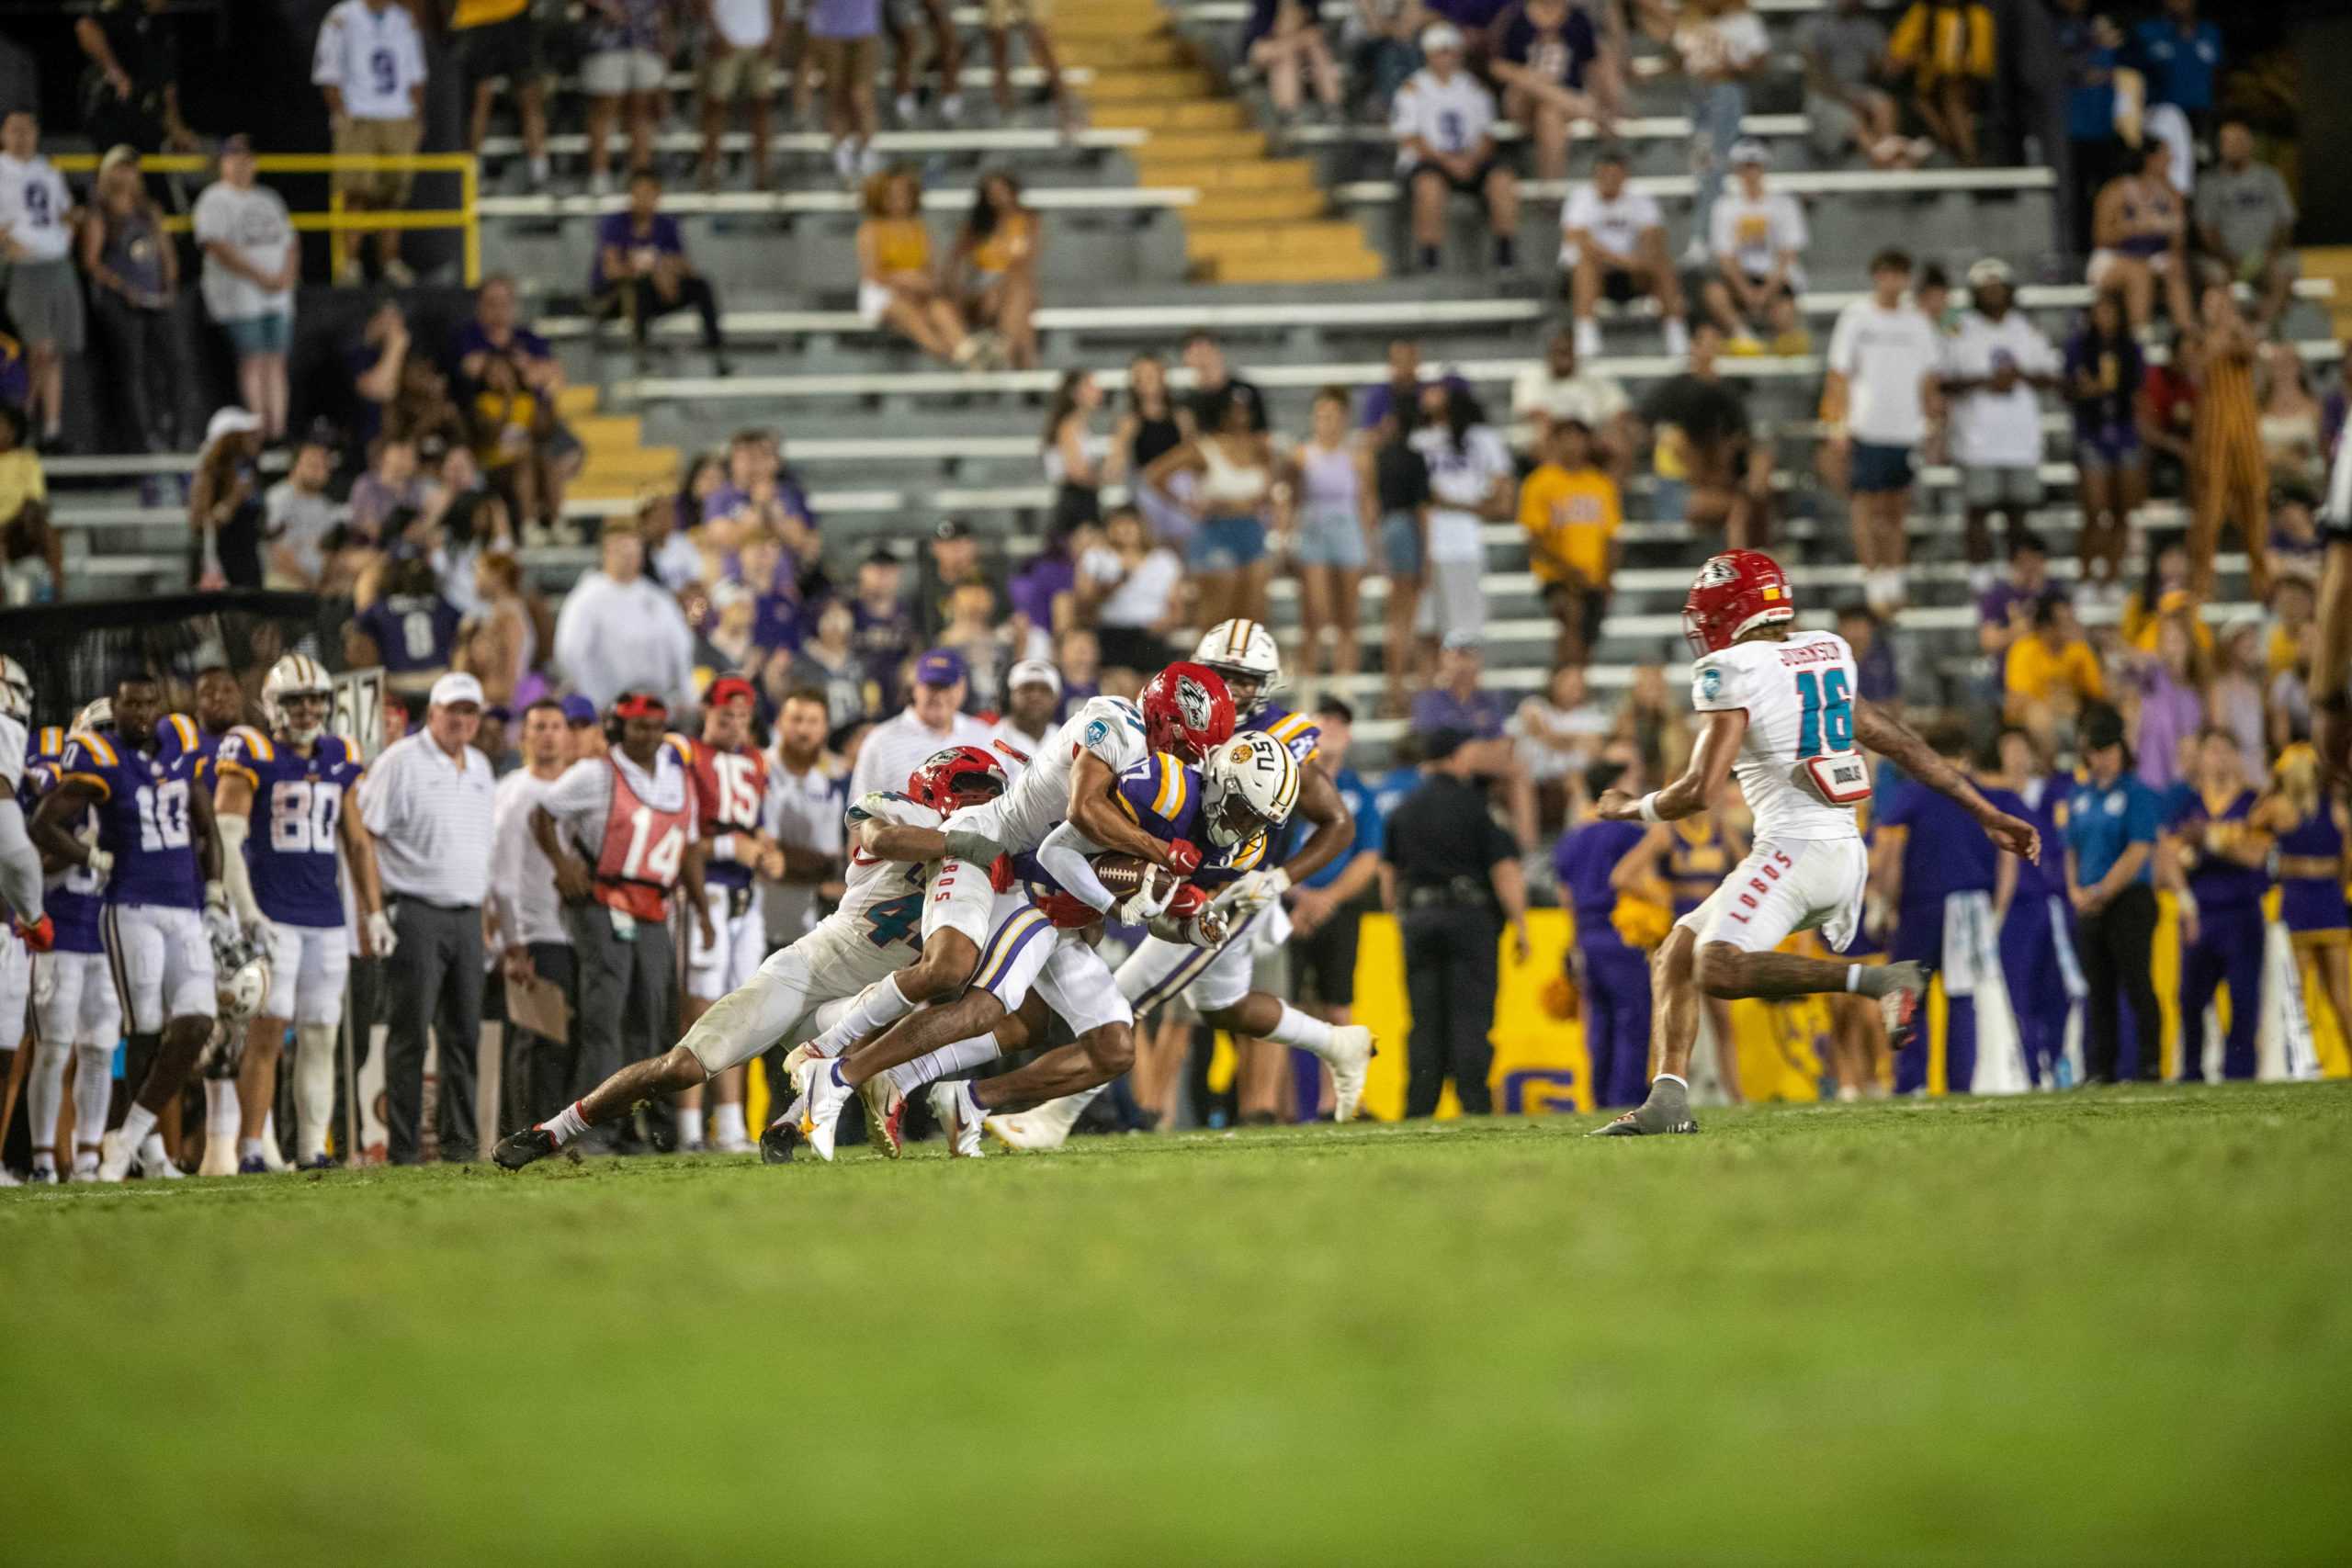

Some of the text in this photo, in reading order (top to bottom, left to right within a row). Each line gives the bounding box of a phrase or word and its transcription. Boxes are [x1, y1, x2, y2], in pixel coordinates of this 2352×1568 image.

[370, 46, 397, 96] 9
[25, 179, 50, 228] 9
[1794, 667, 1854, 761] 16
[136, 779, 191, 852] 10
[270, 780, 343, 854] 80
[712, 750, 755, 829] 15
[622, 806, 685, 888] 14
[1728, 850, 1792, 924] LOBOS
